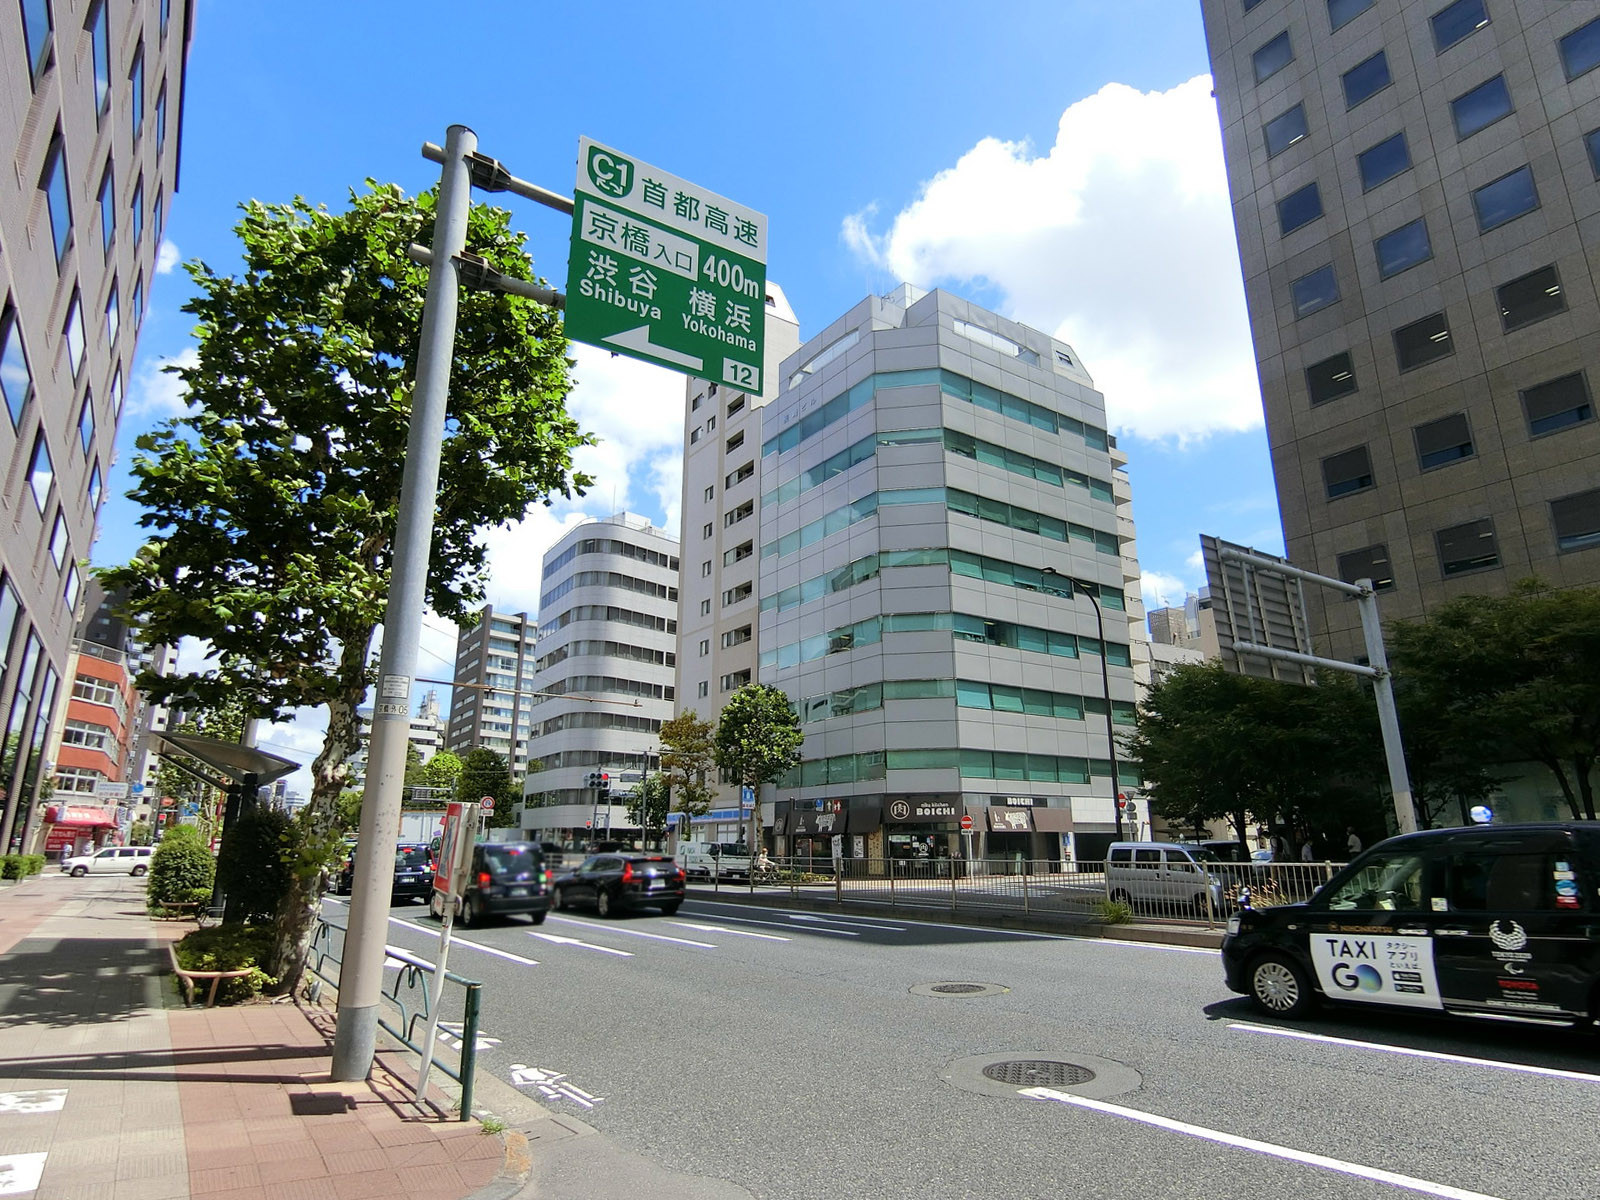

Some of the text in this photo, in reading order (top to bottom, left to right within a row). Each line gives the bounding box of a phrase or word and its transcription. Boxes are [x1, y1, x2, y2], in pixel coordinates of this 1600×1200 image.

[592, 153, 628, 187] C1
[641, 177, 758, 249] 首都高速
[588, 209, 692, 273] 京橋入口
[586, 250, 658, 300] 渋谷
[703, 254, 760, 299] 400m
[579, 278, 662, 320] Shibuya
[688, 286, 751, 334] 横浜
[682, 313, 757, 352] Yokohama
[729, 364, 753, 385] 12
[916, 807, 956, 816] BOICHI
[1007, 797, 1033, 806] BOICHI
[1326, 938, 1377, 960] TAXI
[1386, 941, 1417, 950] タクシー
[1387, 951, 1419, 962] アプリ
[1331, 962, 1383, 993] GO
